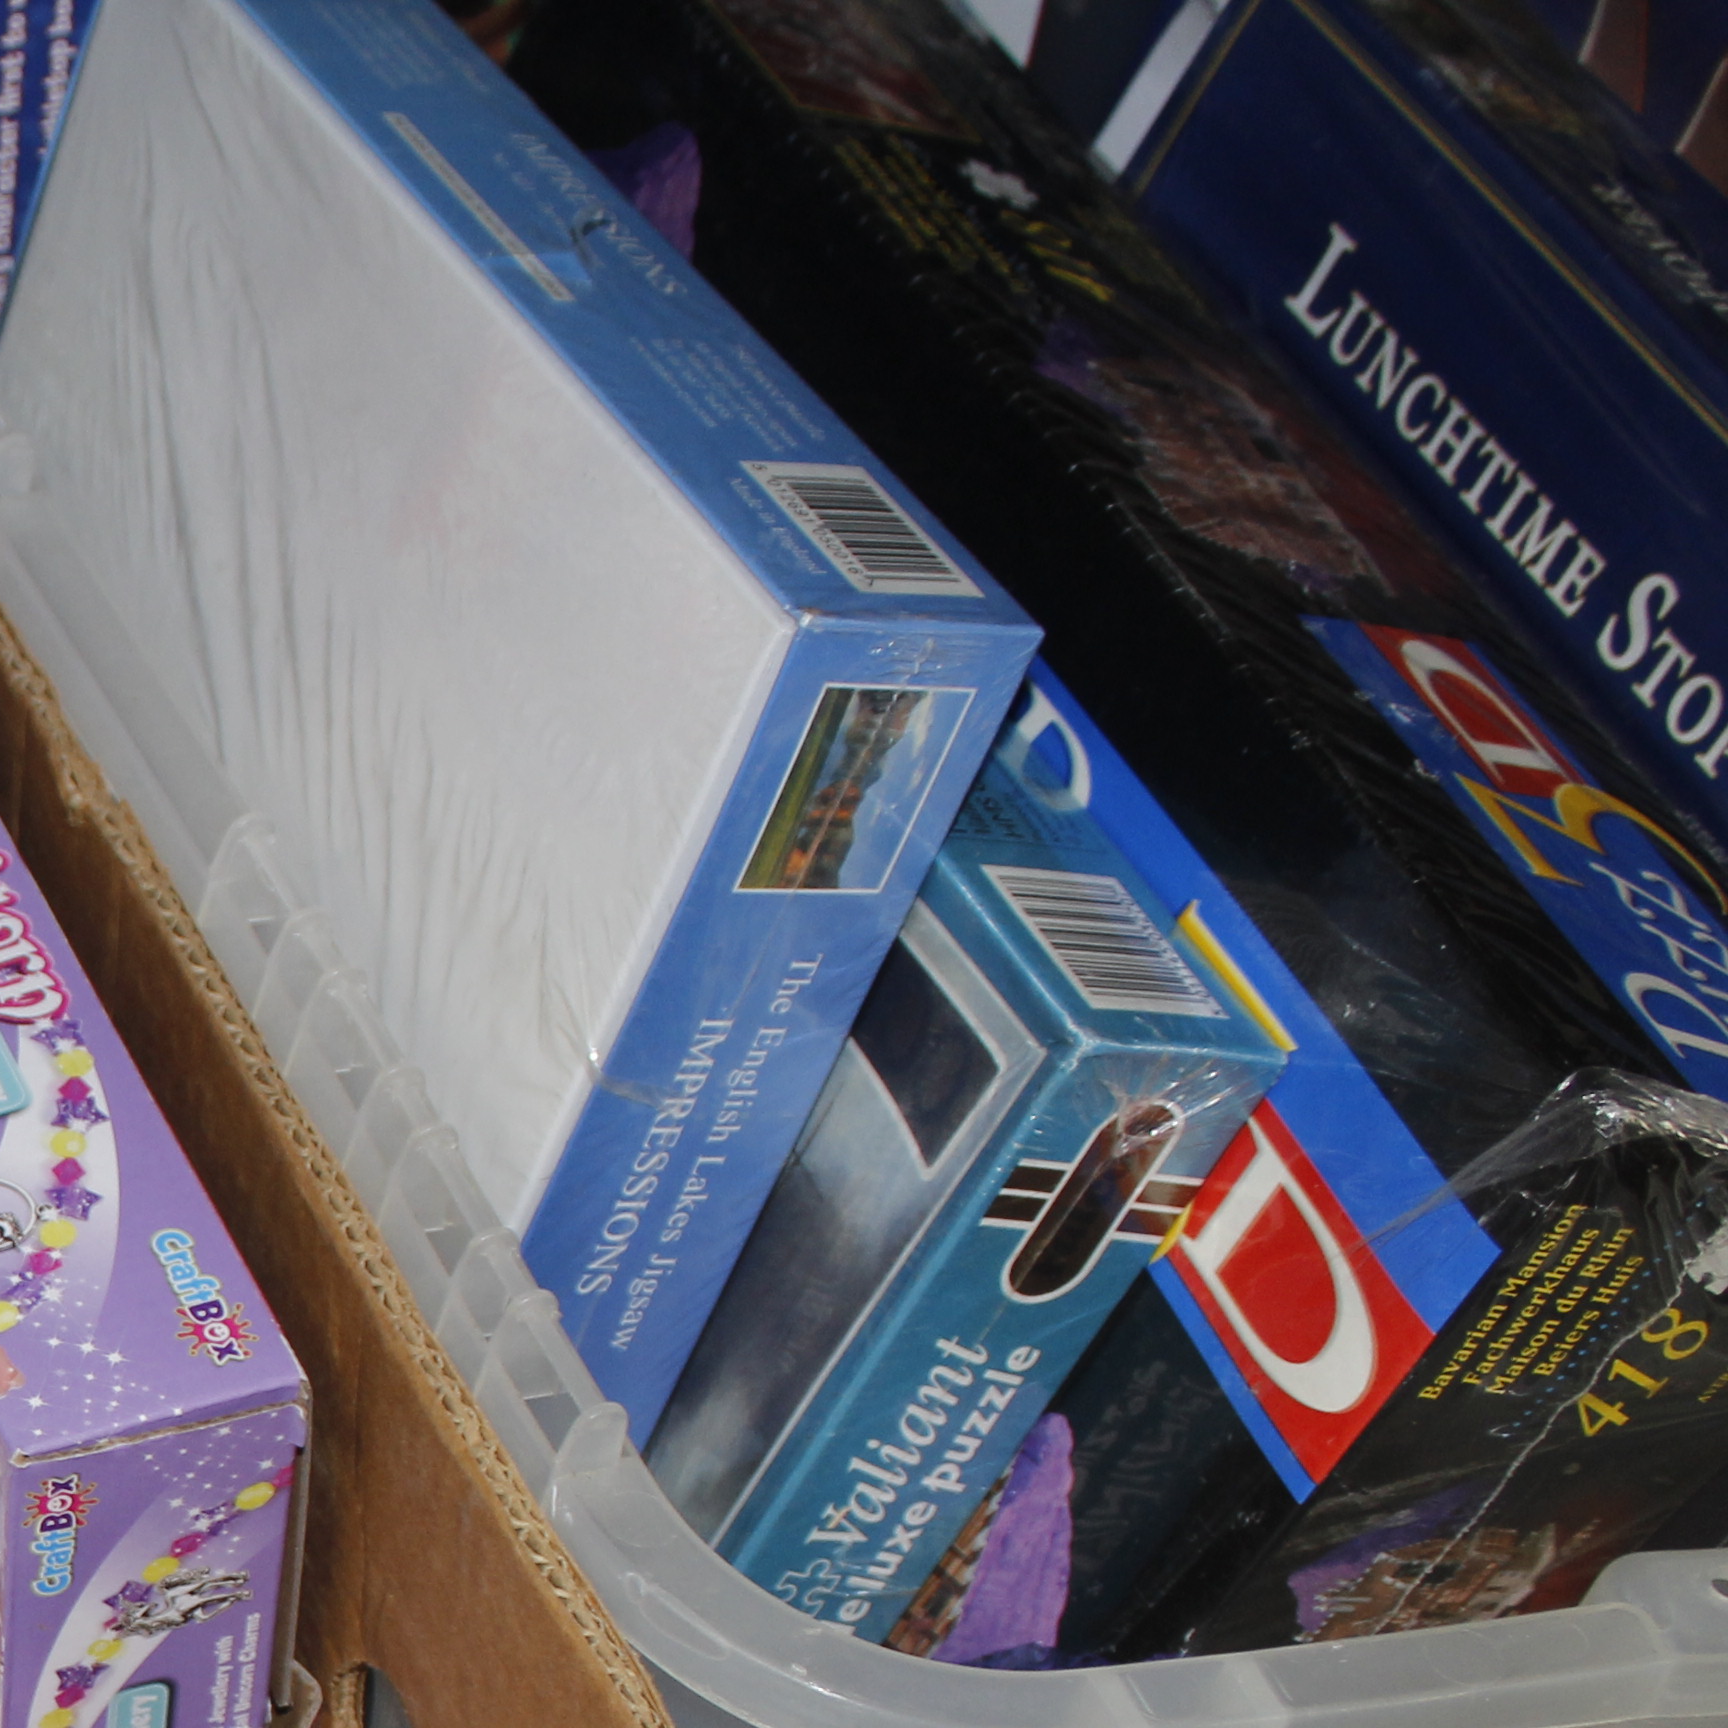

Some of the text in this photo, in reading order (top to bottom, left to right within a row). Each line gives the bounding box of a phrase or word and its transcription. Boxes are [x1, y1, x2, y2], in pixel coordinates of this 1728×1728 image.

[1285, 222, 1606, 619] LUNCHTIME
[610, 953, 824, 1352] The English Lakes Jigsaw
[1414, 1198, 1592, 1405] Bavarian Mansion
[1455, 1222, 1607, 1390] Fachwerkhaus
[1483, 1220, 1636, 1400] Maison du Rhin
[1531, 1249, 1646, 1381] Beiers Huis
[1577, 1308, 1709, 1438] 418
[804, 1335, 990, 1549] Valiant
[921, 1344, 1041, 1494] puzzle
[205, 1665, 235, 1722] Jewellery
[213, 1635, 234, 1664] with
[231, 1663, 258, 1712] Unicorn
[237, 1613, 265, 1662] Charms
